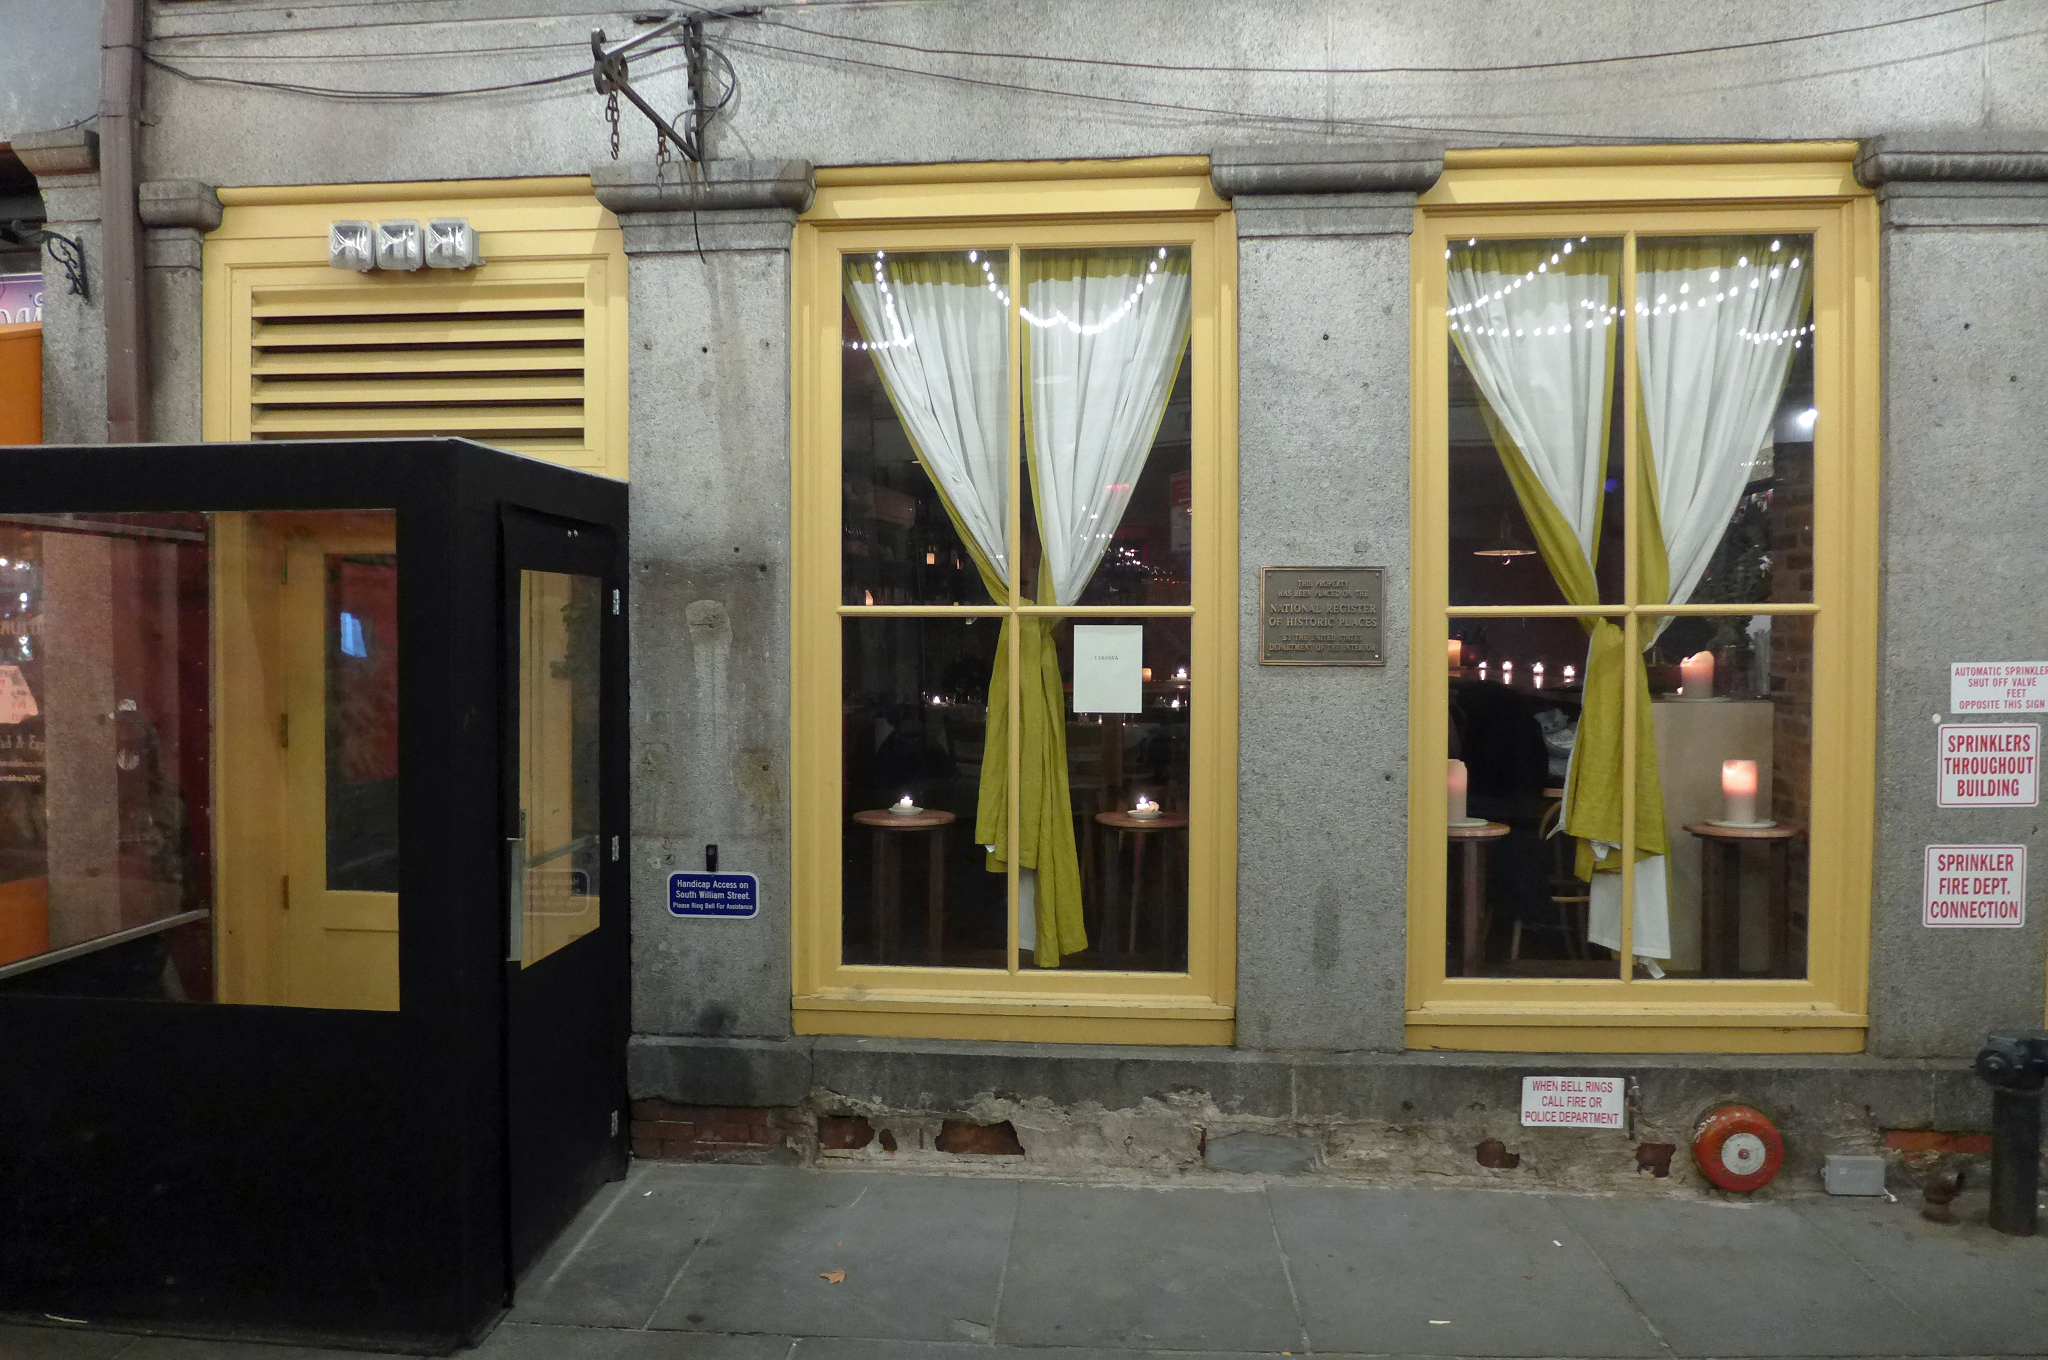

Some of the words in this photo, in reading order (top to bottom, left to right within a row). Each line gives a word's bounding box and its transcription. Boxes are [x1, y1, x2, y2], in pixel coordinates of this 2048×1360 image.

[1298, 580, 1313, 588] THIS
[1315, 580, 1349, 588] PROPERTY
[1278, 589, 1292, 598] HAS
[1294, 589, 1312, 598] BEEN
[1314, 589, 1341, 598] PLACED
[1342, 589, 1352, 598] ON
[1354, 589, 1369, 598] THE
[1270, 603, 1322, 613] NATIONAL
[1326, 603, 1376, 614] REGISTER
[1268, 617, 1282, 627] OF
[1286, 617, 1335, 627] HISTORIC
[1339, 617, 1378, 627] PLACES
[1294, 633, 1309, 641] THE
[1311, 633, 1336, 641] UNITED
[1339, 633, 1363, 642] STATES
[1269, 643, 1313, 651] DEPARTMENT
[1315, 643, 1325, 651] OF
[1327, 643, 1341, 651] THE
[1343, 643, 1376, 652] INTERIOR
[1954, 666, 2002, 677] AUTOMATIC
[1968, 678, 1989, 688] SHUT
[1992, 678, 2009, 687] OFF
[2012, 677, 2037, 687] VALVE
[2006, 688, 2027, 698] FEET
[1959, 700, 2000, 710] OPPOSITE
[2003, 700, 2023, 709] THIS
[2025, 699, 2045, 709] SIGN
[1947, 734, 2031, 753] SPRINKLERS
[1944, 756, 2034, 775] THROUGHOUT
[1956, 778, 2020, 797] BUILDING
[1937, 853, 2014, 872] SPRINKLER
[677, 879, 711, 889] Handicap
[712, 880, 738, 889] Access
[1938, 877, 1970, 895] FIRE
[1973, 877, 2011, 895] DEPT.
[675, 890, 697, 899] South
[699, 890, 725, 899] William
[691, 902, 704, 910] Ring
[1930, 900, 2018, 919] CONNECTION
[1532, 1080, 1559, 1092] WHEN
[1560, 1080, 1583, 1092] BELL
[1585, 1081, 1613, 1093] RINGS
[1541, 1095, 1564, 1107] CALL
[1566, 1096, 1587, 1108] FIRE
[1588, 1096, 1603, 1108] OR
[1525, 1110, 1557, 1122] POLICE
[1558, 1111, 1619, 1125] DEPARTMENT
